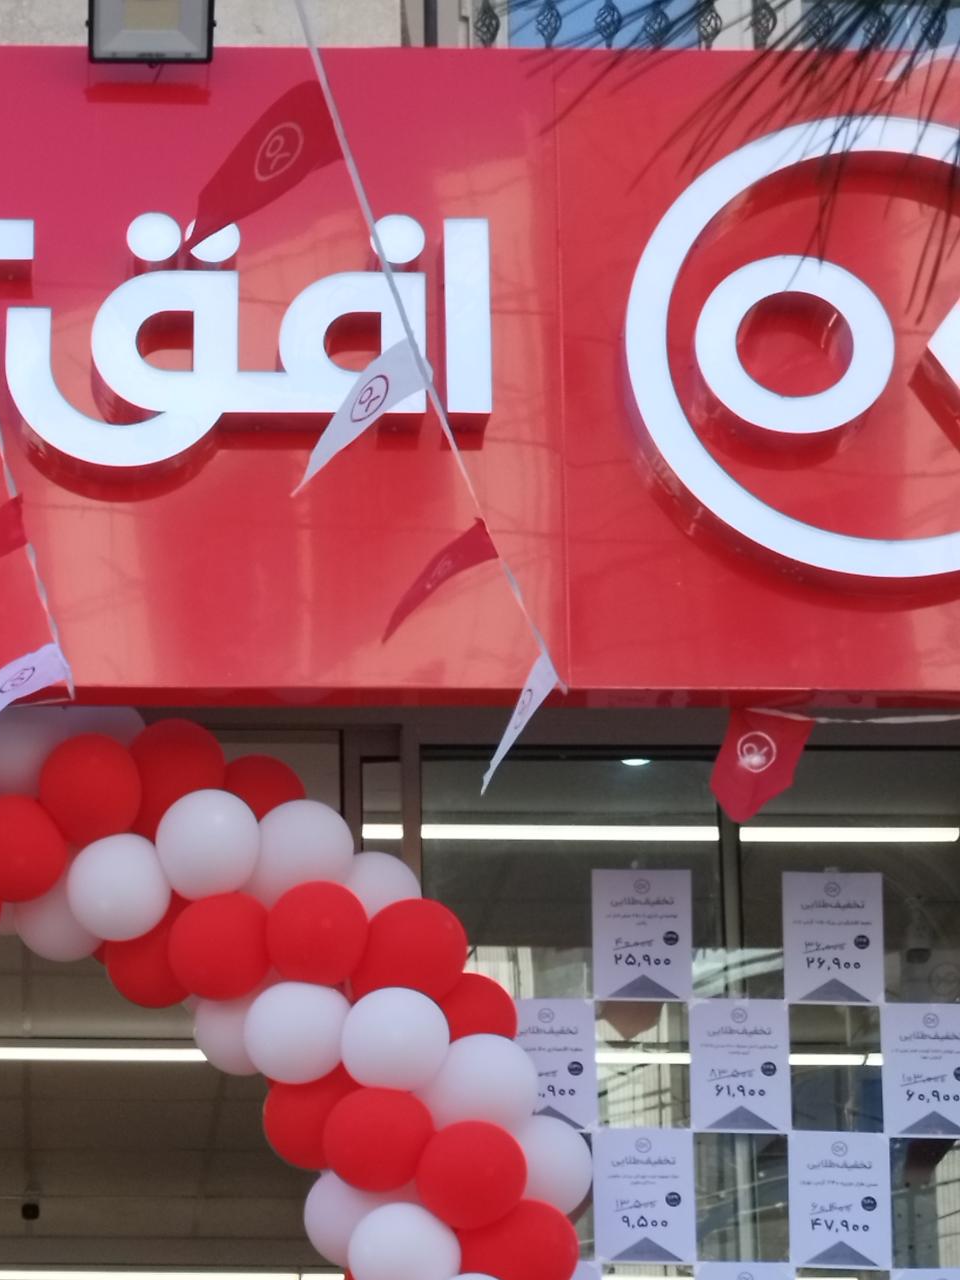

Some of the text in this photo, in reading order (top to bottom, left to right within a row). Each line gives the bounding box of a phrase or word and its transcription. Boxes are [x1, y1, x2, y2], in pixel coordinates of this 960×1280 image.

[5, 212, 491, 467] افق
[614, 953, 671, 968] ۲۵,۹۰۰
[806, 956, 861, 971] ۲۶,۹۰۰
[715, 1084, 766, 1098] ۶۱,۹۰۰
[622, 1215, 668, 1229] ۹,۵۰۰
[811, 1218, 870, 1233] ۴۷,۹۰۰
